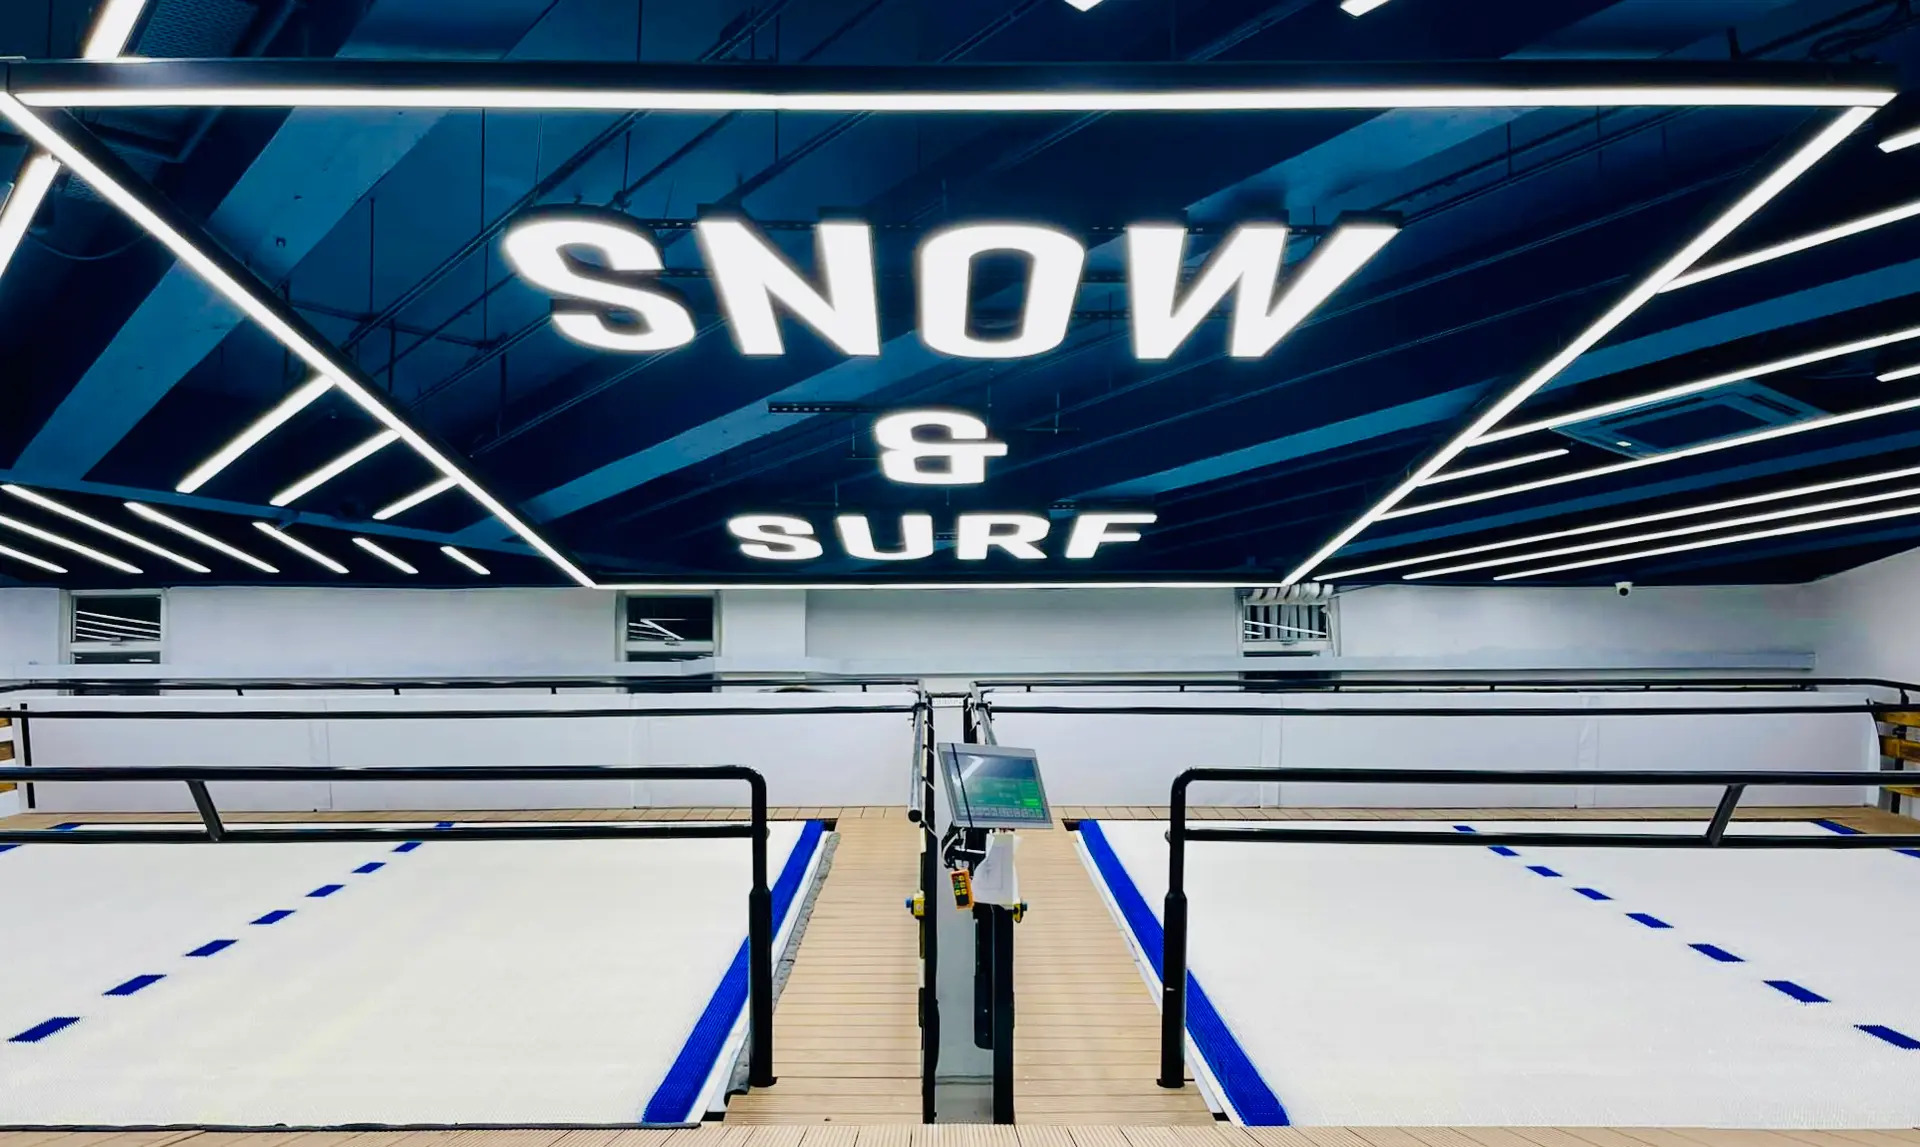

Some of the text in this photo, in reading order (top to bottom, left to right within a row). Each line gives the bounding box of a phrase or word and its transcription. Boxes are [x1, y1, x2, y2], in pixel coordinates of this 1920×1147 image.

[503, 218, 1400, 359] SNOW
[873, 410, 1009, 486] &
[727, 512, 1158, 561] SURF
